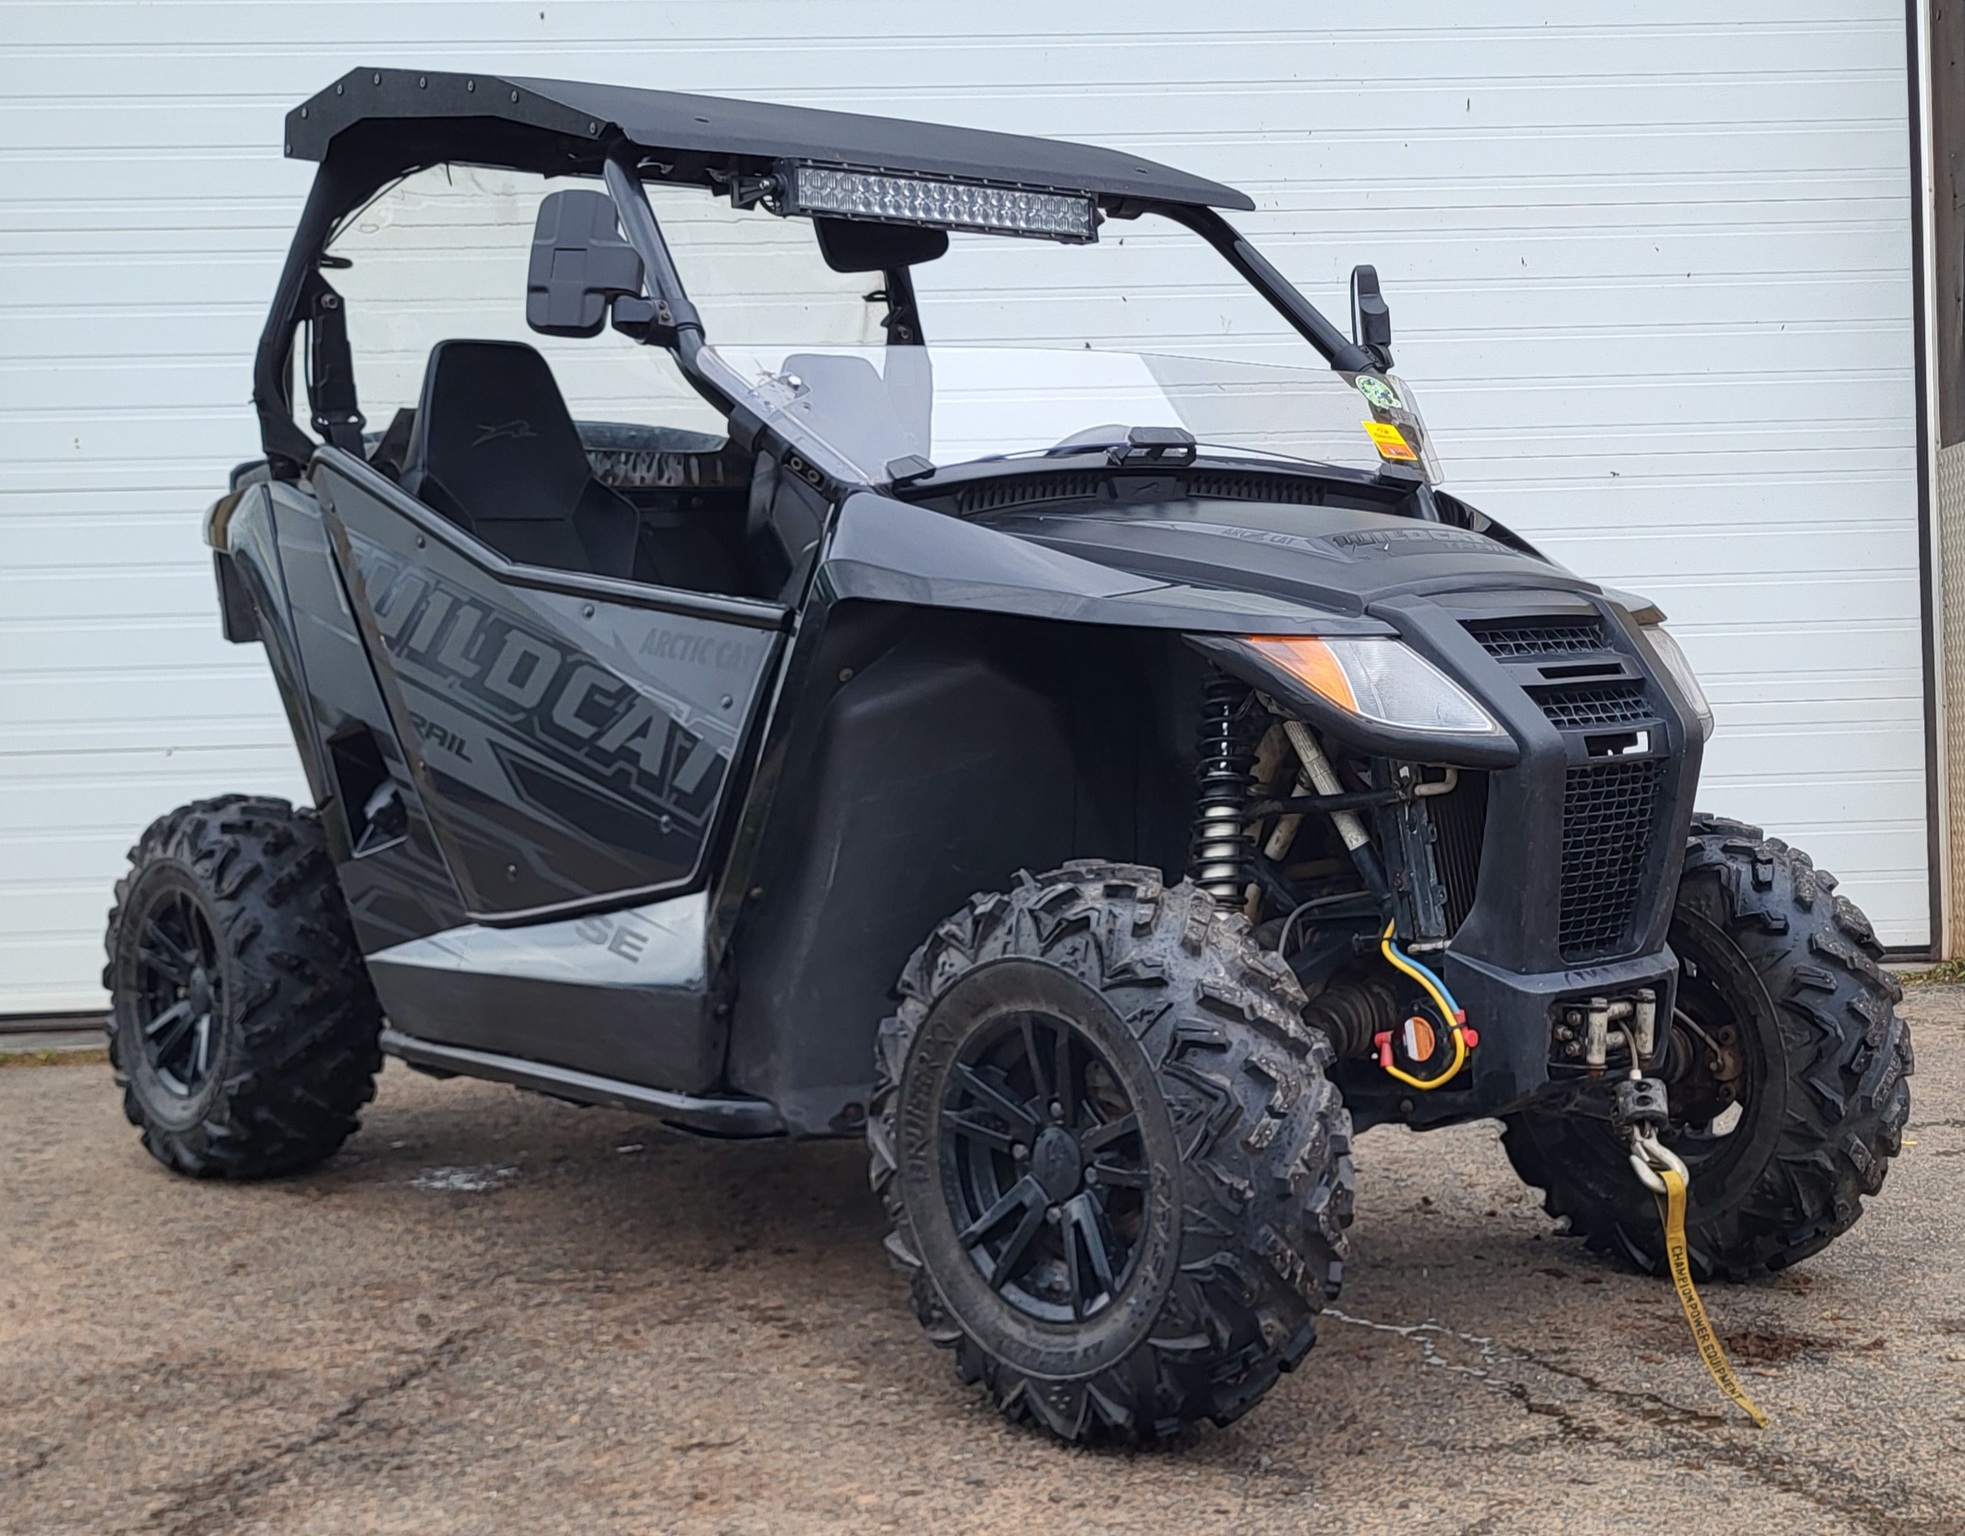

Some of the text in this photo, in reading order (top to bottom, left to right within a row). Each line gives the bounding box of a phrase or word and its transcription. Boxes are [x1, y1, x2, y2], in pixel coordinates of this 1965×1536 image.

[639, 627, 716, 666] ARCTIC
[408, 710, 473, 764] RAIL
[575, 915, 649, 964] SE
[1671, 1244, 1744, 1400] CHAMPION POWER EQUIPMENT
